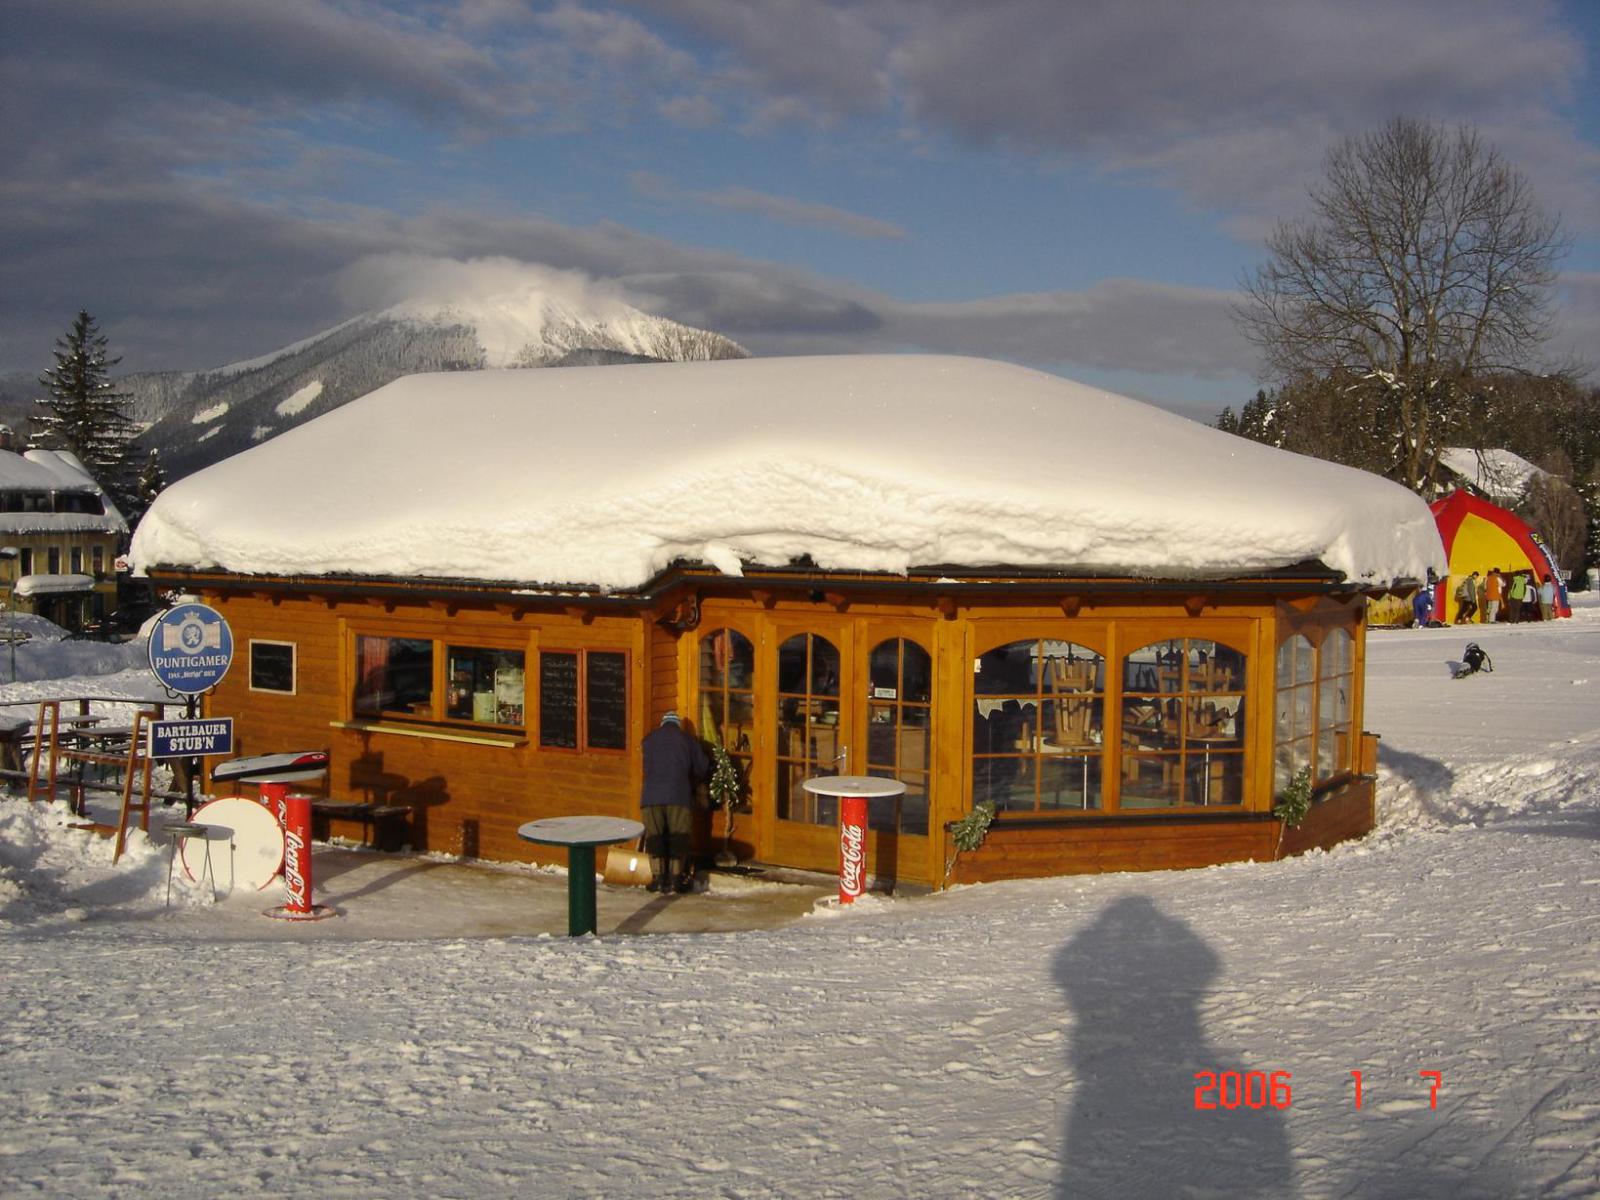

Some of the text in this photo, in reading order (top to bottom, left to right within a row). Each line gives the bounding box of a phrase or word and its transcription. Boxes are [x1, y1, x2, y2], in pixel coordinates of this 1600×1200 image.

[155, 655, 228, 669] PUNTIGAMER
[157, 724, 227, 738] BARTLBAUER
[169, 736, 215, 752] STUB'N
